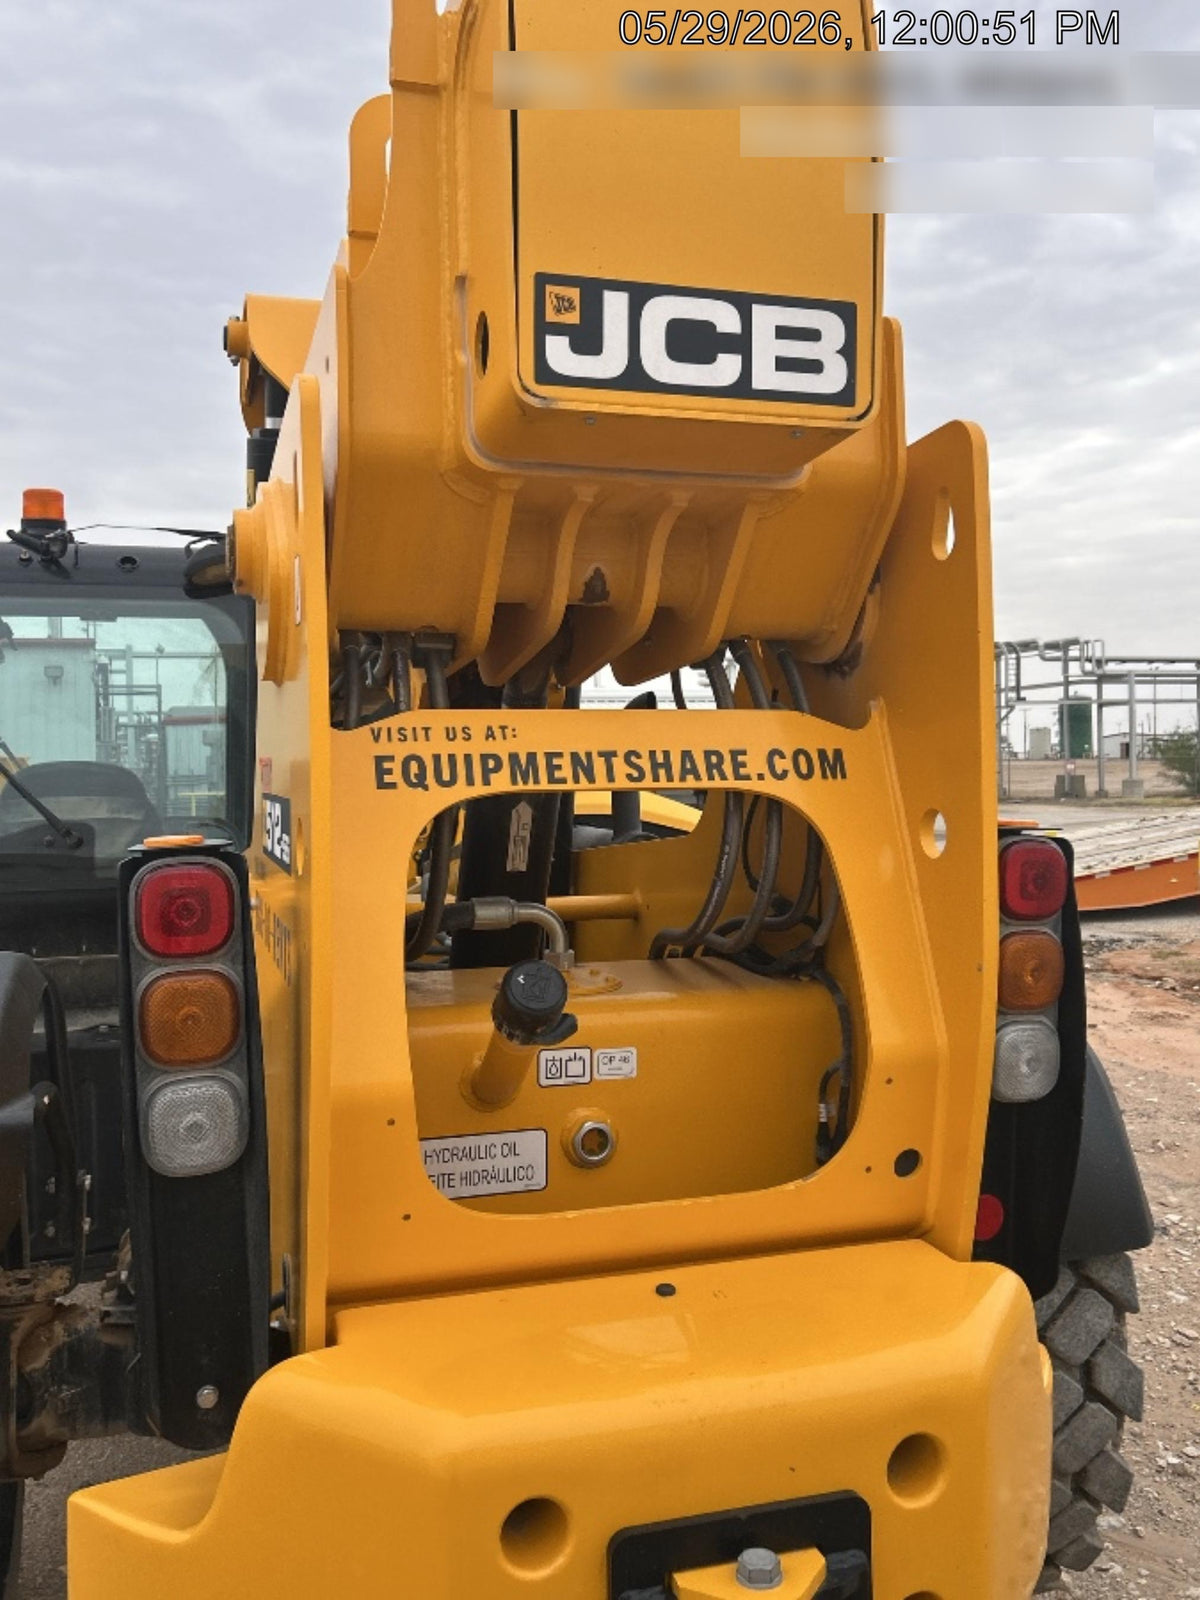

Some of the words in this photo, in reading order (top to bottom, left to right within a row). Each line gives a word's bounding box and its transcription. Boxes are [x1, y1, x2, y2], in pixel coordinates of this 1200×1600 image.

[545, 289, 849, 395] JCB
[370, 726, 432, 743] VISIT
[445, 726, 472, 742] US
[485, 725, 518, 742] AT:
[374, 747, 848, 791] EQUIPMENTSHARE.COM
[424, 1143, 497, 1165] HYDRAULIC
[500, 1141, 520, 1158] OIL
[459, 1164, 535, 1187] HIDRÁULICO
